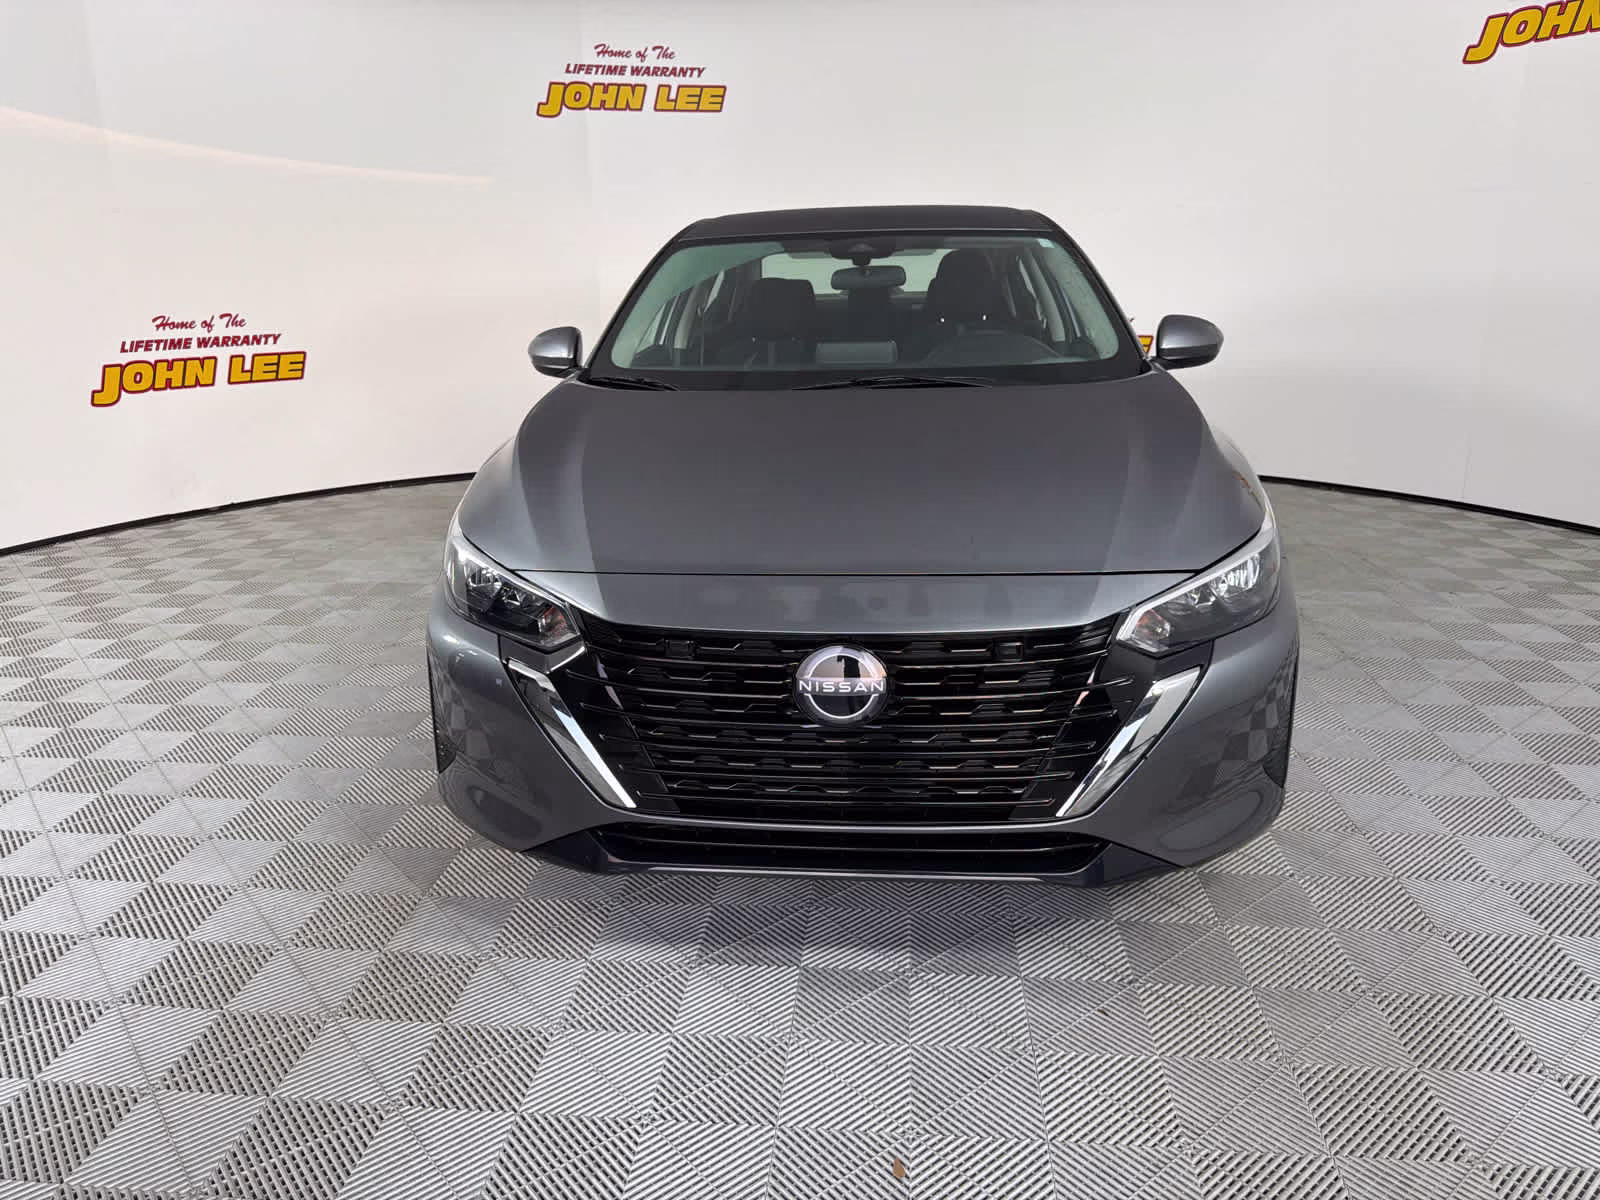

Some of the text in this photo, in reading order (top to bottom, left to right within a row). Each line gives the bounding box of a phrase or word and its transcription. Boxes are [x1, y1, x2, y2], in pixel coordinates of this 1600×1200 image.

[594, 43, 676, 63] Home of The
[564, 63, 705, 78] LIFETIME WARRANTY
[537, 81, 727, 118] JOHN LEE
[152, 313, 247, 333] Home of The
[120, 333, 282, 353] LIFETIME WARRANTY
[91, 351, 306, 407] JOHN LEE
[799, 680, 884, 693] NISSAN
